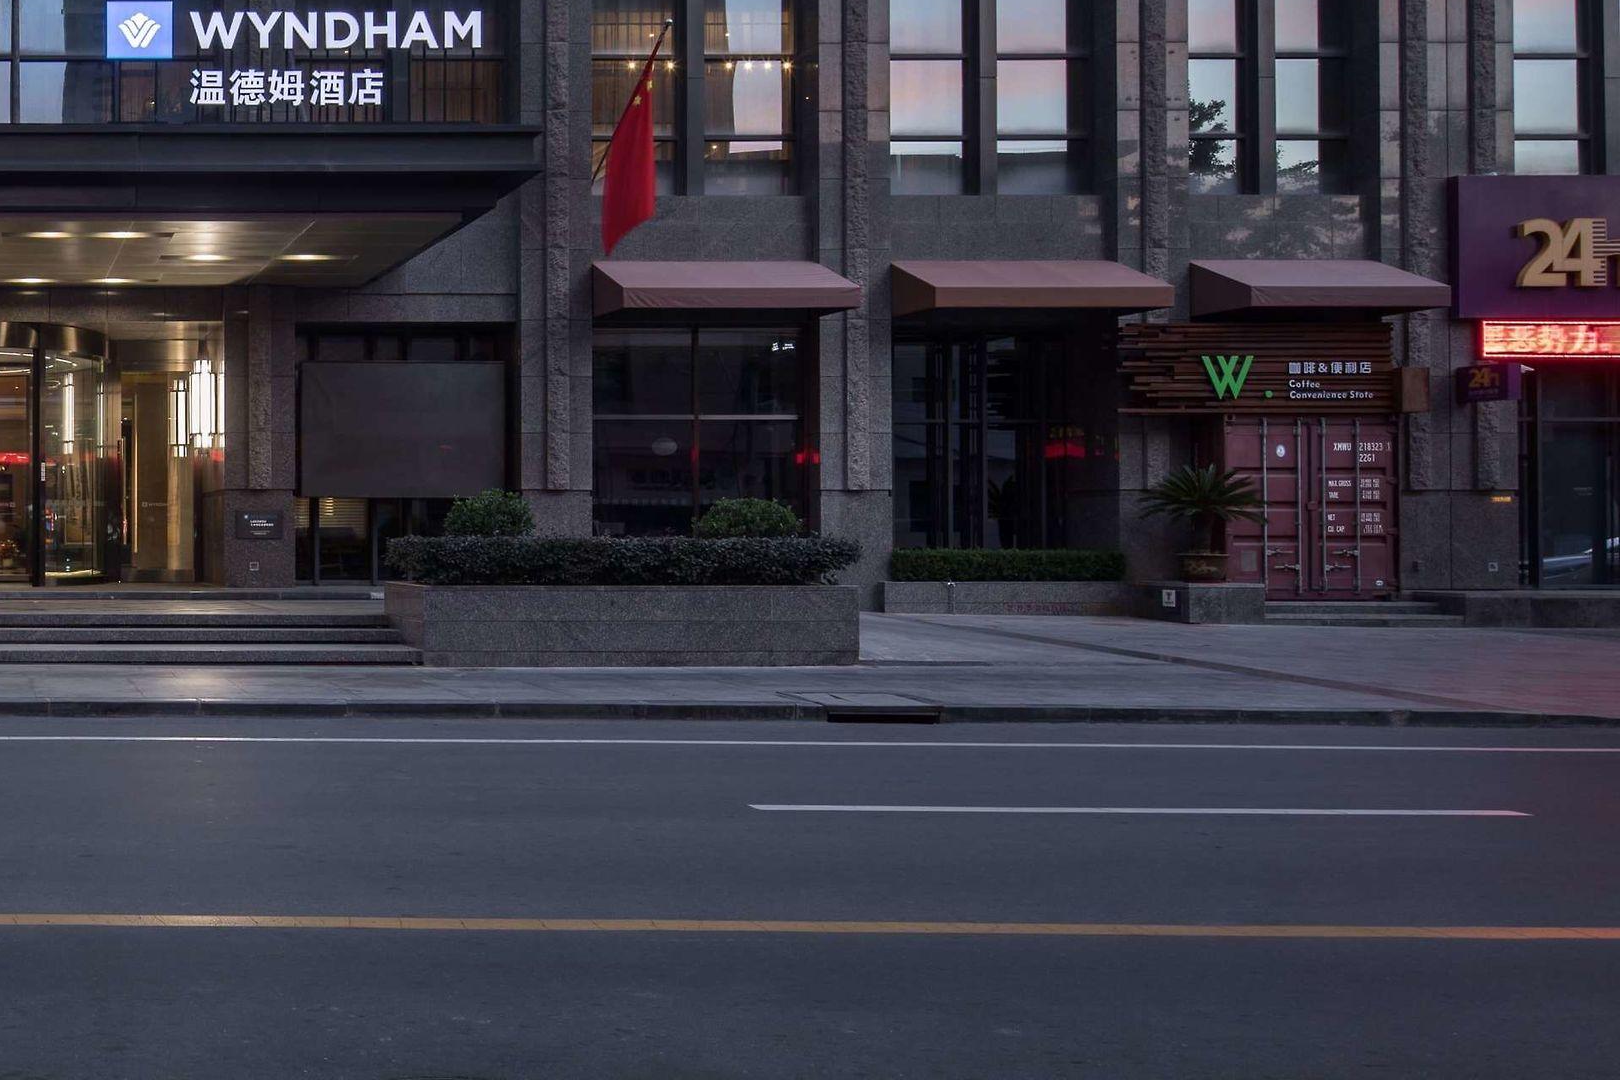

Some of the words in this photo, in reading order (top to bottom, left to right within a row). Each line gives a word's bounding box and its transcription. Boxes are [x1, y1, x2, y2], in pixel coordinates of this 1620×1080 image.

[189, 11, 482, 49] WYNDHAM
[189, 69, 383, 106] 温德姆酒店
[1288, 362, 1372, 374] 咖啡&便利店
[1288, 379, 1320, 388] Coffee
[1289, 390, 1347, 399] Convenience
[1359, 442, 1383, 451] 218323
[1359, 453, 1375, 462] 22G1
